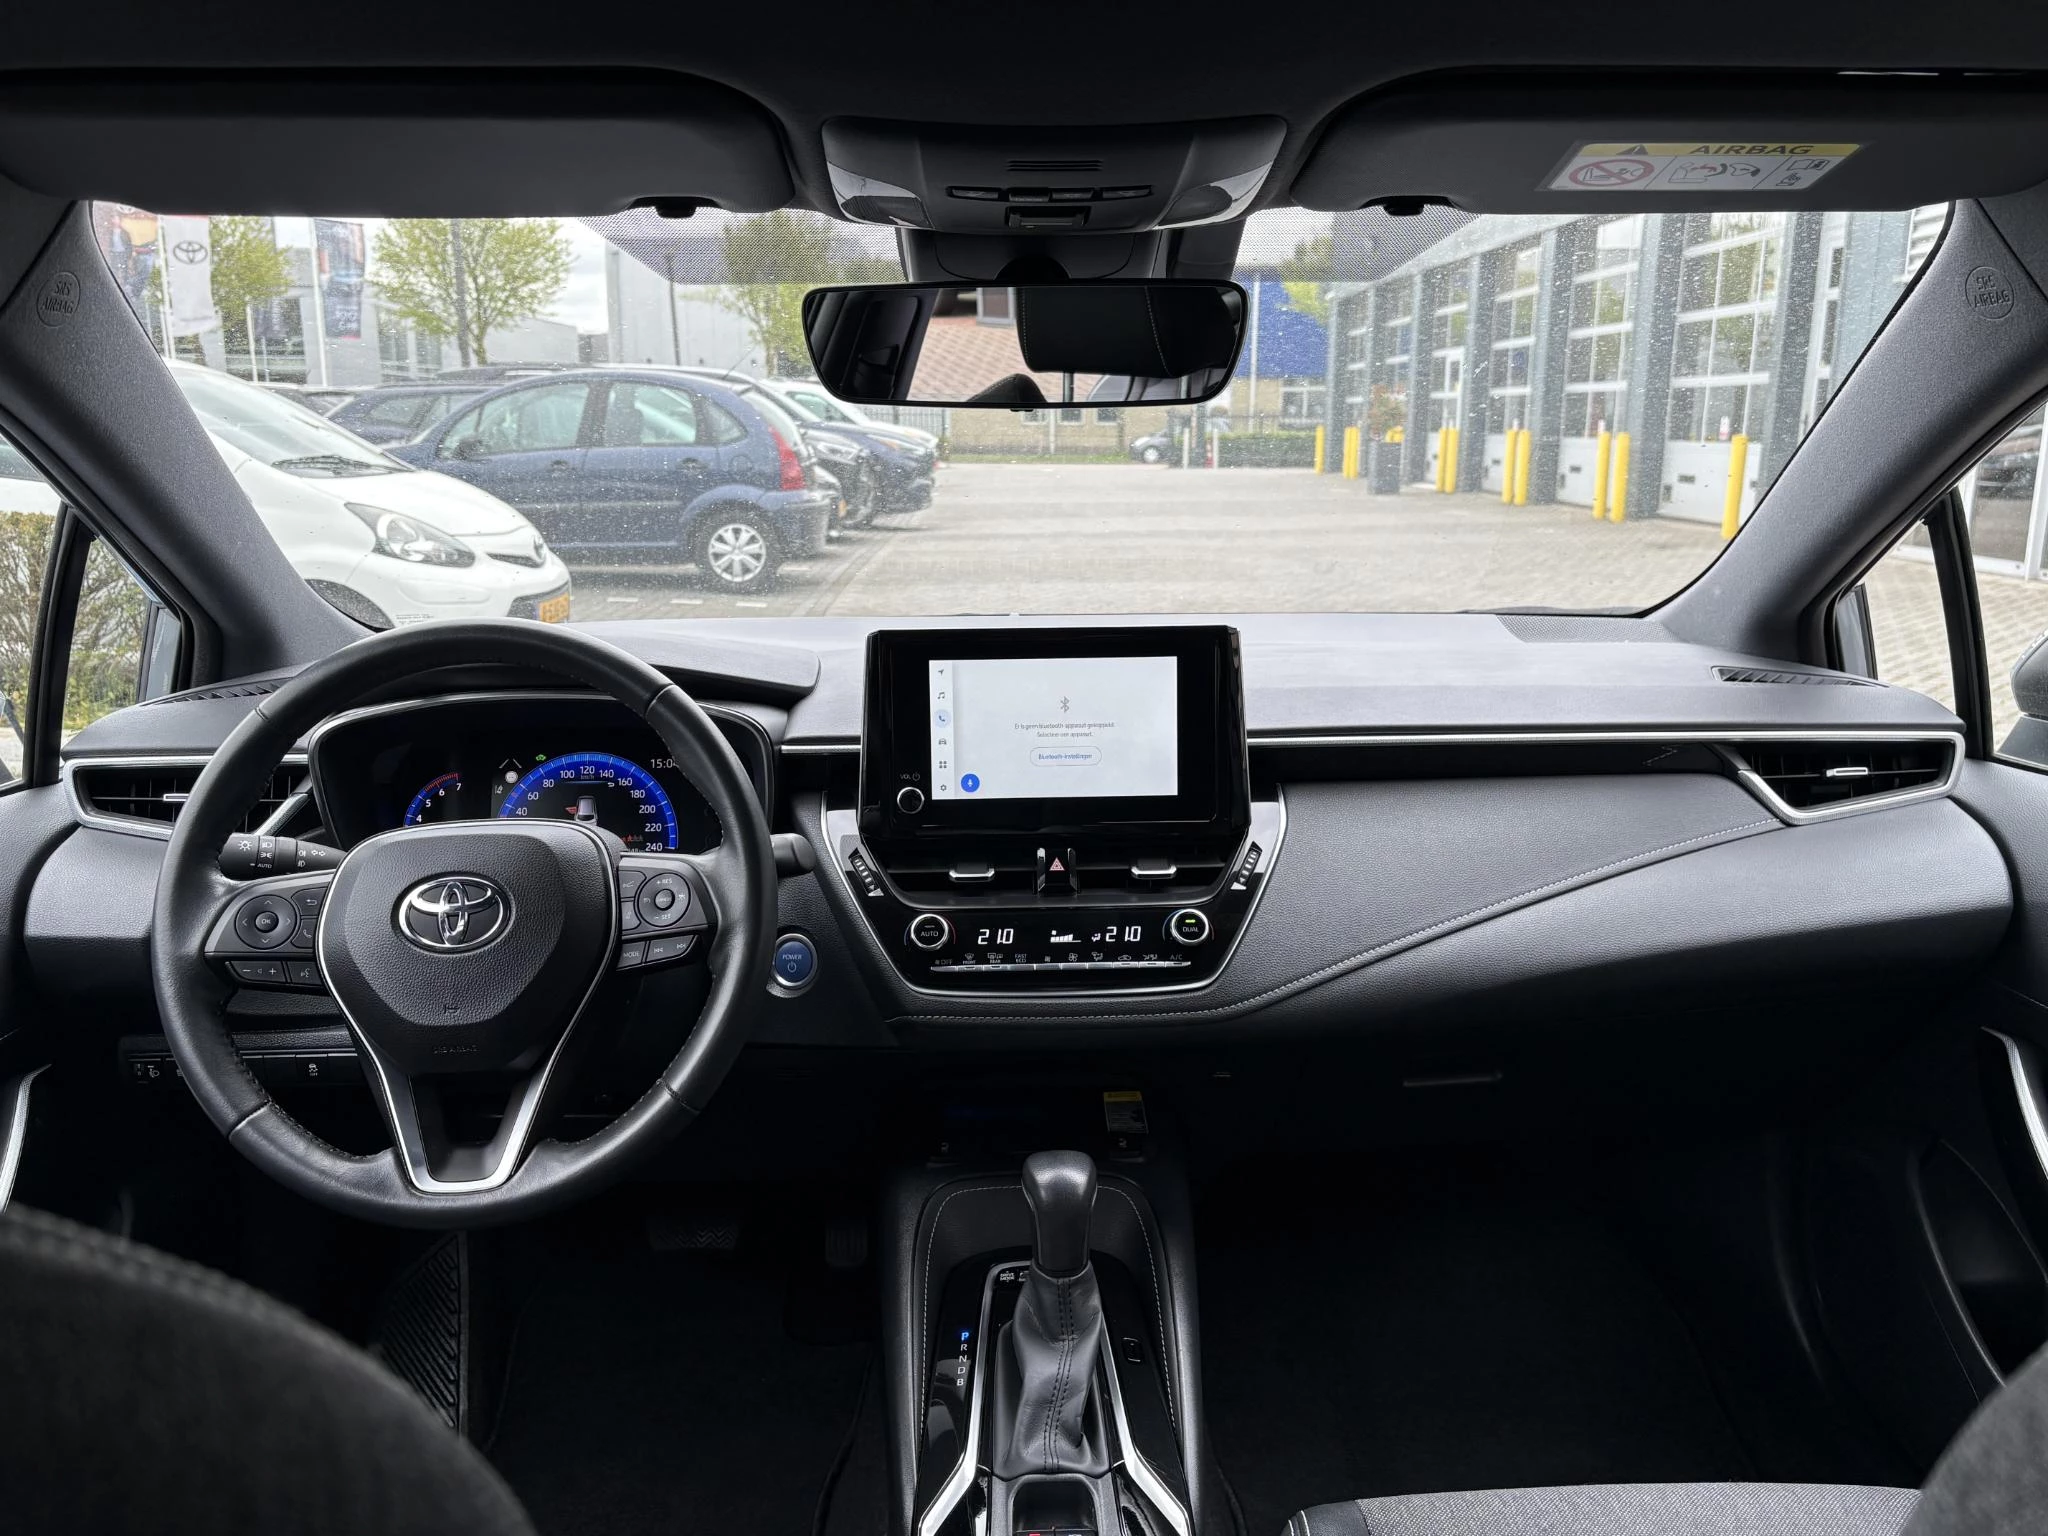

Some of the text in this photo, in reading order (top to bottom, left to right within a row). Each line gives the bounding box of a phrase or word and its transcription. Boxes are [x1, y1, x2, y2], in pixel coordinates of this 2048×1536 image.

[1689, 145, 1814, 155] AIRBAG
[1973, 290, 2010, 308] AIRBAG
[40, 297, 75, 314] AIRBAG
[560, 769, 575, 779] 100
[580, 766, 595, 775] 120
[599, 769, 614, 778] 140
[542, 779, 555, 788] 80
[618, 777, 633, 786] 160
[456, 782, 462, 791] 7
[439, 788, 445, 796] 6
[527, 792, 539, 801] 60
[630, 789, 646, 799] 180
[425, 799, 432, 807] 5
[516, 807, 528, 816] 40
[639, 804, 656, 814] 200
[416, 814, 422, 823] 4
[645, 823, 662, 832] 220
[645, 842, 663, 852] 240
[961, 1332, 969, 1341] P
[960, 1343, 968, 1351] R
[958, 1355, 967, 1363] N
[957, 1366, 966, 1375] D
[956, 1378, 964, 1386] B
